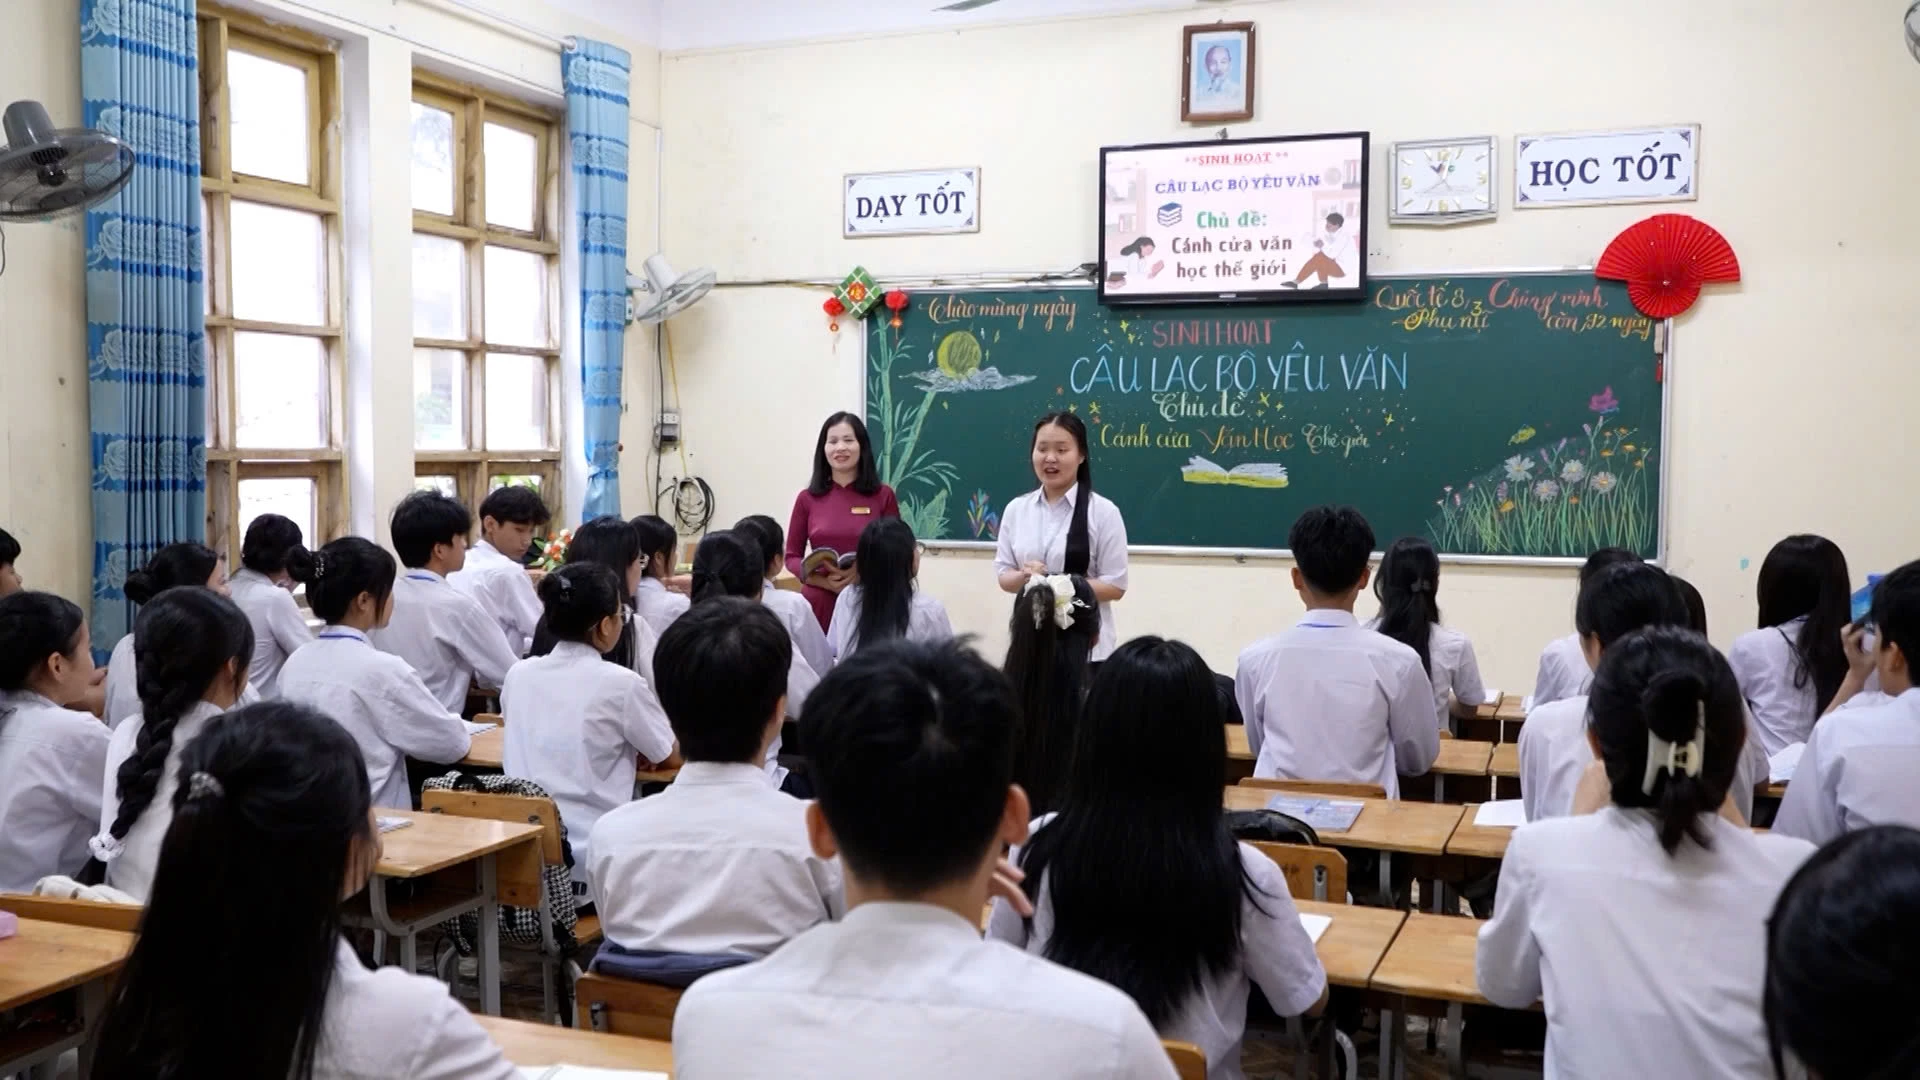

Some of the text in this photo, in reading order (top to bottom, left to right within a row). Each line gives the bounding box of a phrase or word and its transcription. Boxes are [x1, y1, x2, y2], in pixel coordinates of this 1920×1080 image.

[1529, 141, 1681, 192] HỌC TỐT
[1155, 178, 1187, 194] CÂU
[1191, 179, 1223, 195] LẠC
[1252, 173, 1283, 189] YÊU
[856, 181, 966, 223] DẠY TỐT
[1196, 209, 1268, 229] Chủ đề:
[1172, 235, 1292, 254] Cánh cửa văn
[1176, 257, 1287, 281] học thế giới
[923, 294, 976, 324] Chào
[1033, 295, 1077, 331] ngày
[1152, 319, 1210, 348] SINH
[1070, 343, 1142, 394] CÂU
[1267, 341, 1330, 393] YÊU
[1339, 345, 1407, 391] VĂN
[1100, 421, 1152, 449] Cánh
